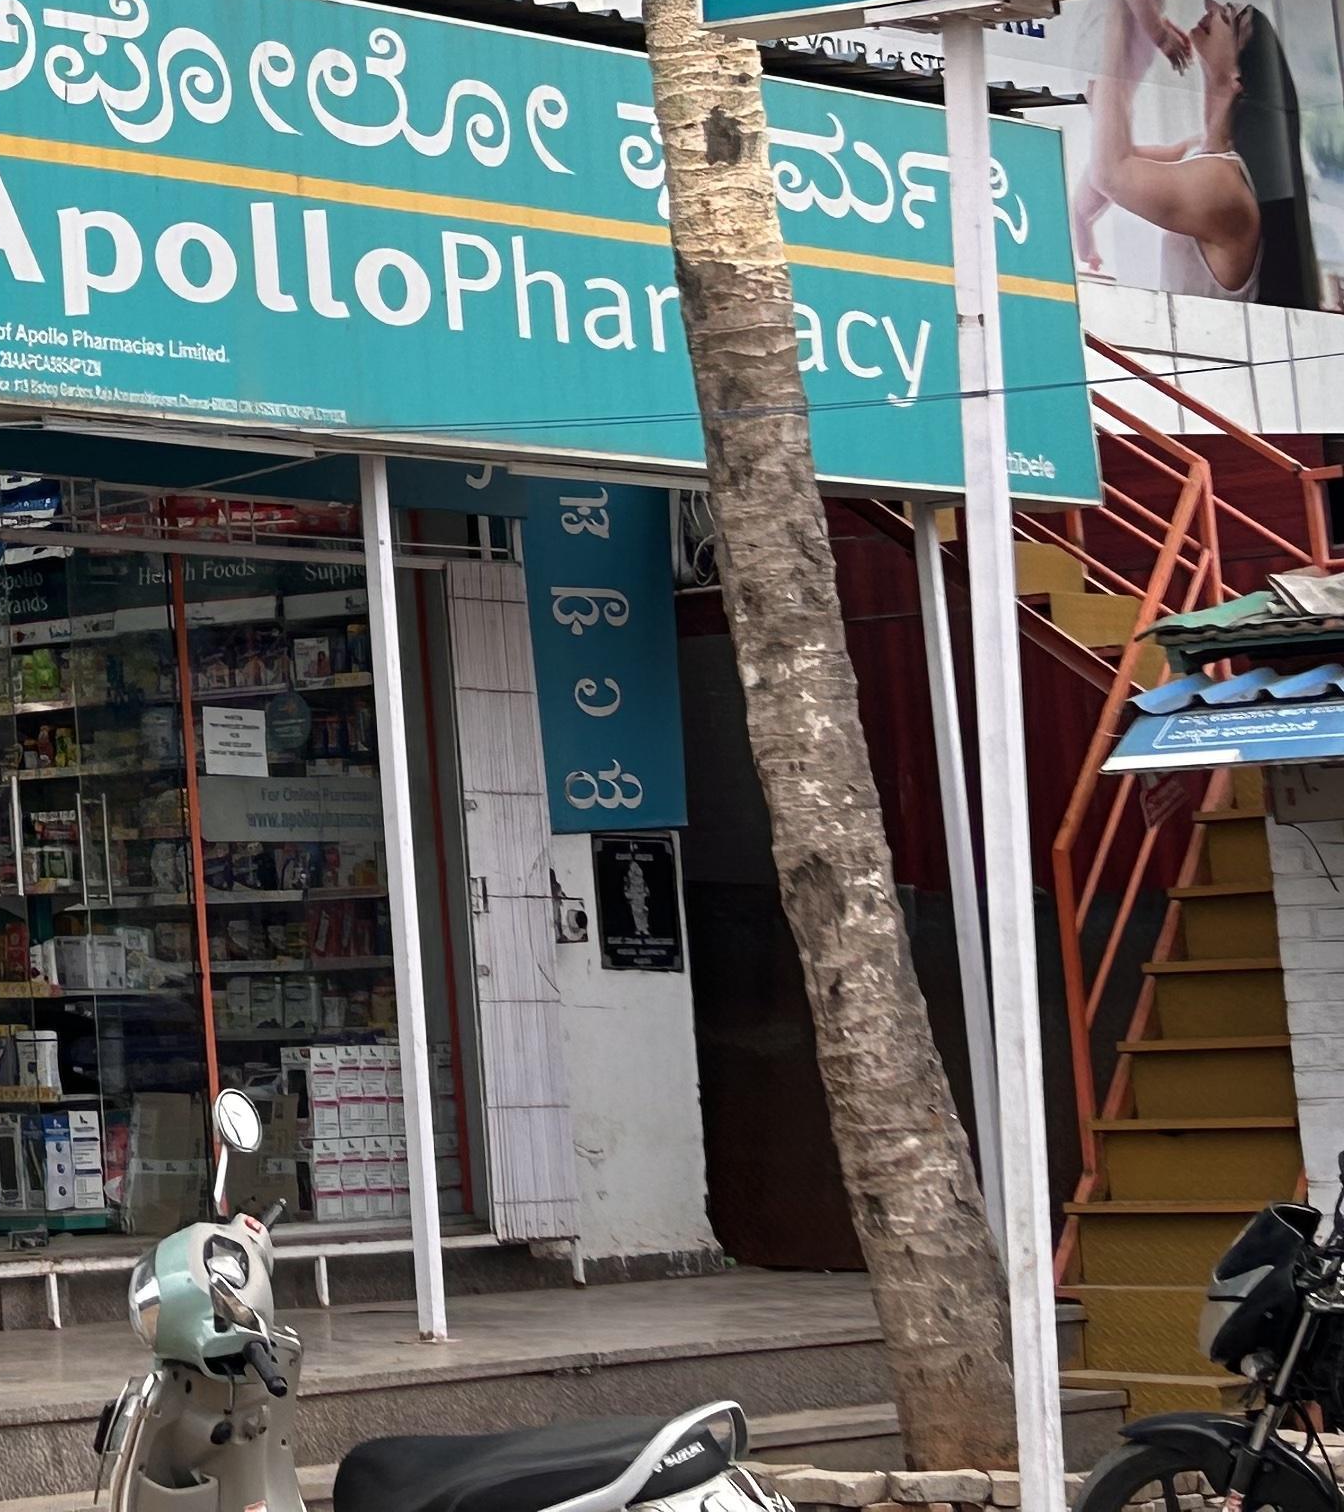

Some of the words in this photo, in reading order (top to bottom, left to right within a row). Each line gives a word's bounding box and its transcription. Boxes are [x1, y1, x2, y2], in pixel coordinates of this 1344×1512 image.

[911, 51, 944, 70] STE
[15, 324, 68, 347] Apollo
[72, 329, 164, 357] Pharmacies
[169, 340, 230, 363] Limited.
